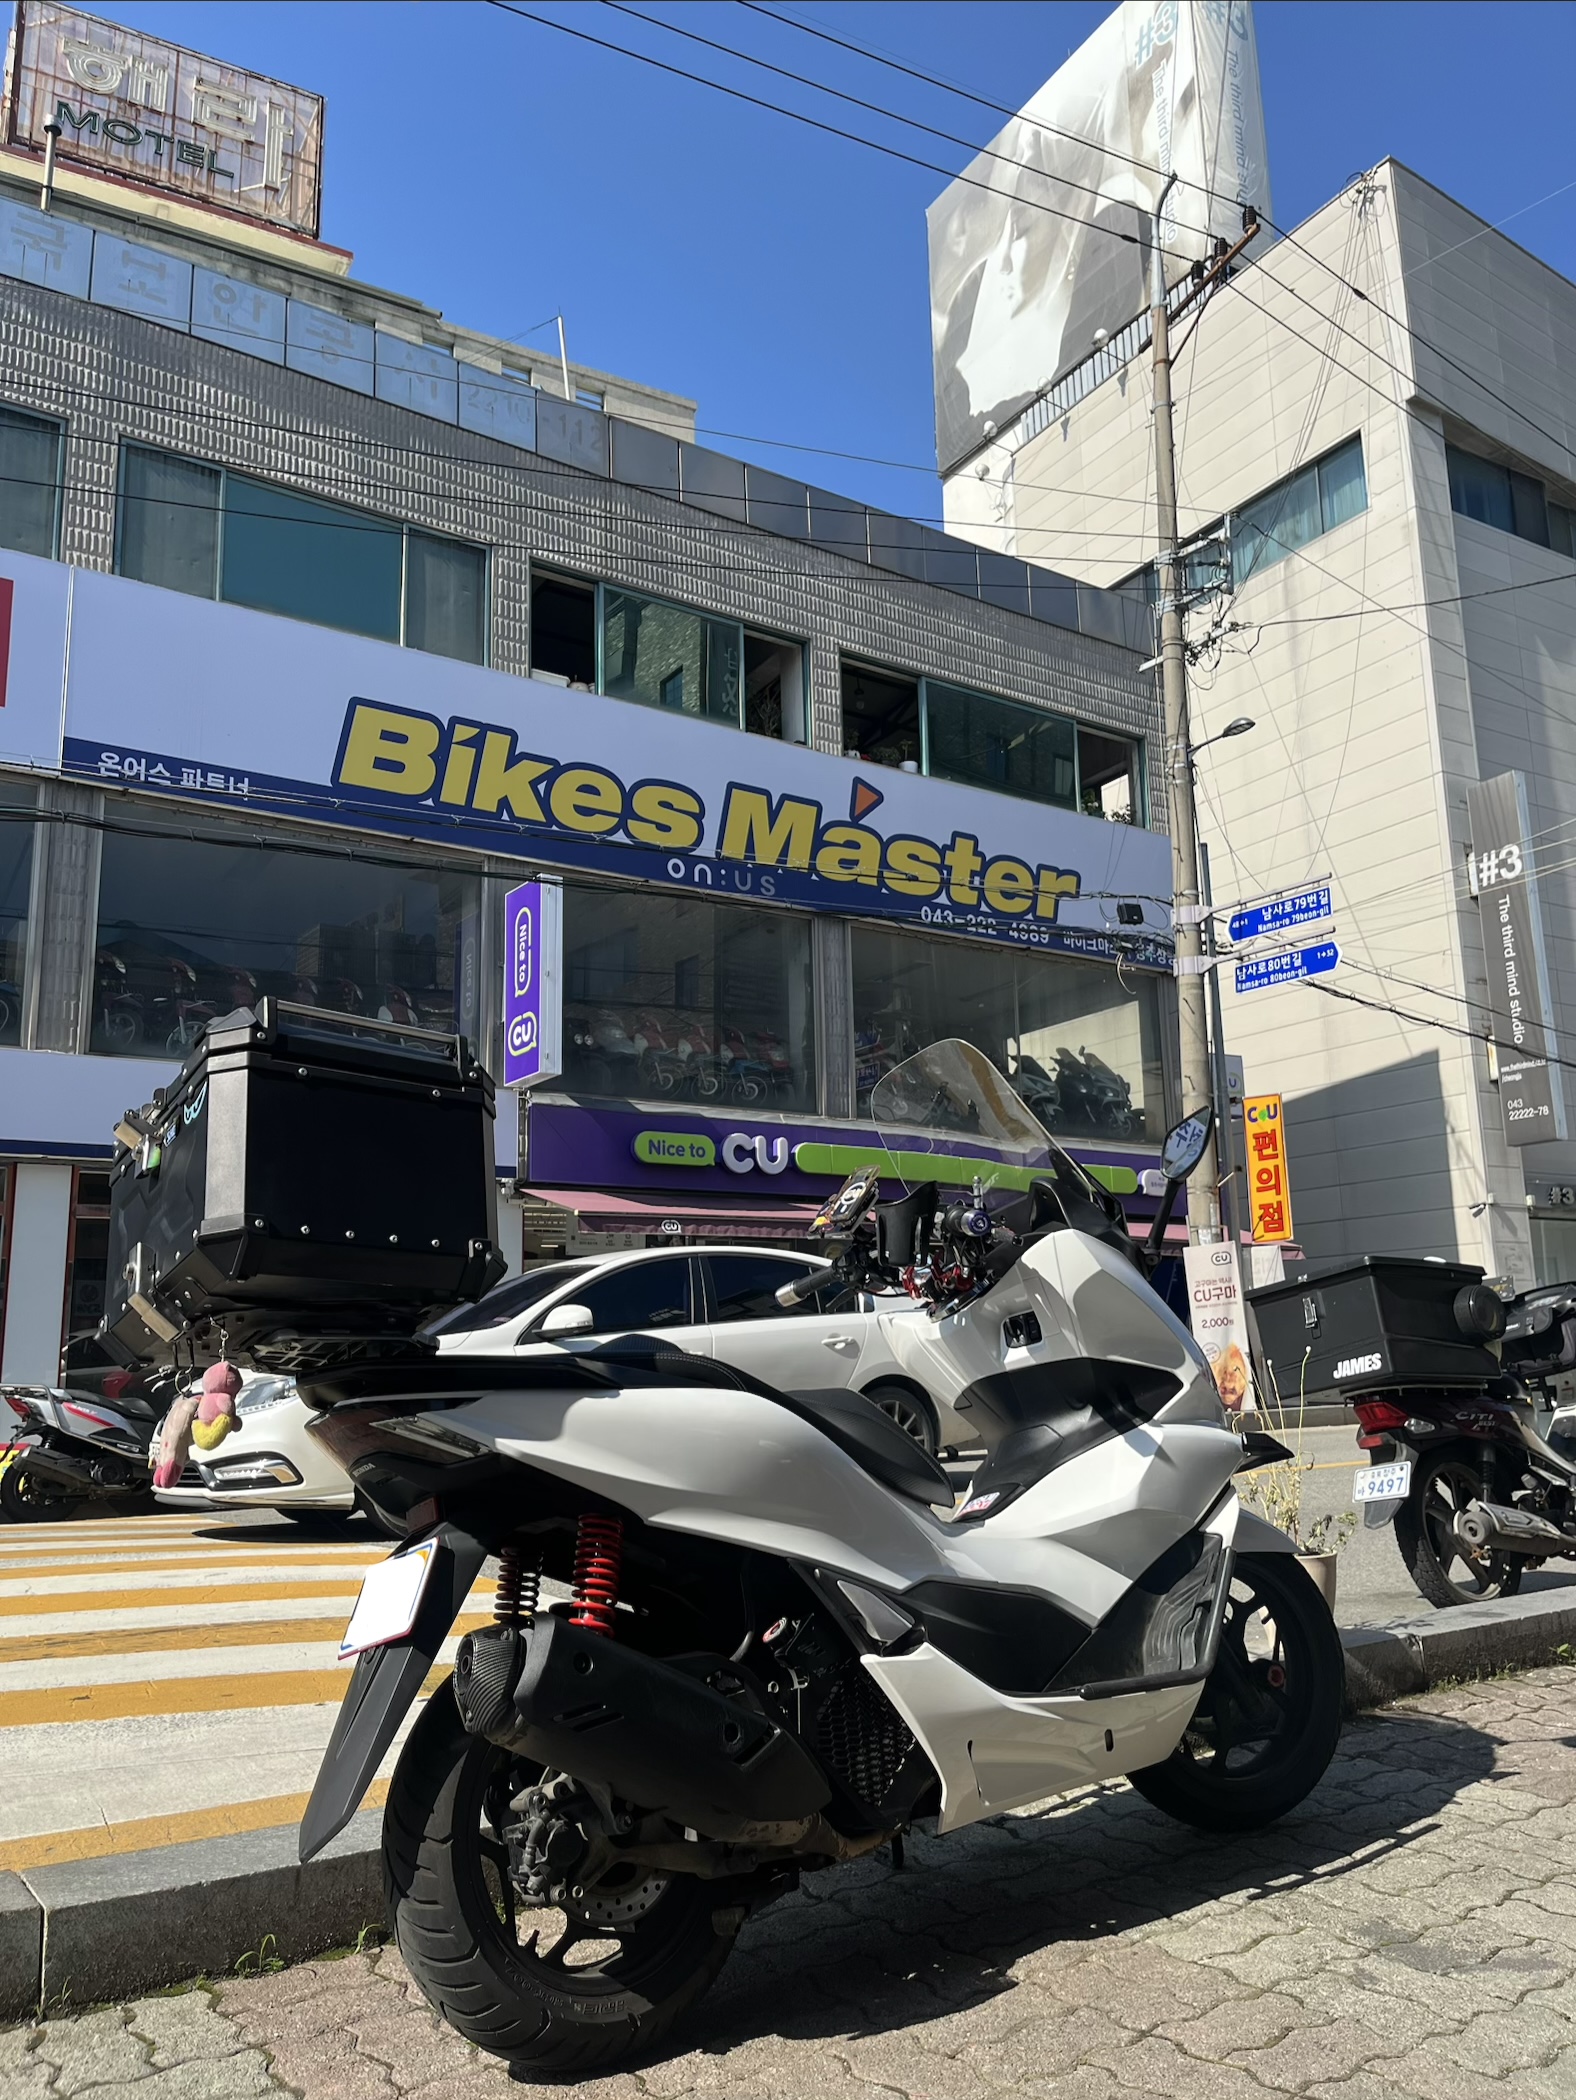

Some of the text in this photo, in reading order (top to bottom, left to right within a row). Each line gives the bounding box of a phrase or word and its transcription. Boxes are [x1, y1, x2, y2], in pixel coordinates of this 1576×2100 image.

[1135, 2, 1177, 68] #3
[1153, 60, 1168, 99] The
[1226, 50, 1239, 77] The
[61, 36, 294, 191] 해라
[1157, 101, 1170, 137] third
[1230, 83, 1244, 123] third
[57, 101, 235, 179] MOTEL
[1235, 125, 1250, 169] mind
[1165, 189, 1178, 242] tudio
[98, 751, 249, 795] 온어스 파트너
[335, 699, 1081, 924] Bikes Master
[666, 857, 776, 896] on:us
[1479, 844, 1523, 888] #3
[1257, 904, 1330, 933] Namsa-ro 79beon-gil
[1262, 889, 1329, 921] 남사로79번길
[518, 923, 528, 983] Nice to
[1236, 951, 1303, 981] 남사로80번길
[1236, 966, 1308, 991] Namsa-ro 80beon-gil
[1498, 894, 1524, 1045] The third mind studio
[512, 1021, 532, 1048] CU
[1246, 1103, 1279, 1123] CU
[1507, 1098, 1524, 1110] 043
[1508, 1105, 1550, 1121] 22222-78
[648, 1139, 706, 1158] Nice to
[721, 1132, 789, 1175] CU
[1252, 1128, 1285, 1234] 편의점
[1550, 1186, 1576, 1205] #3
[664, 1222, 677, 1231] CU
[1214, 1254, 1229, 1264] CU
[1193, 1284, 1237, 1303] CU구마
[1333, 1352, 1383, 1379] JAMES
[352, 1462, 377, 1478] HONDA
[1367, 1476, 1405, 1496] 9497
